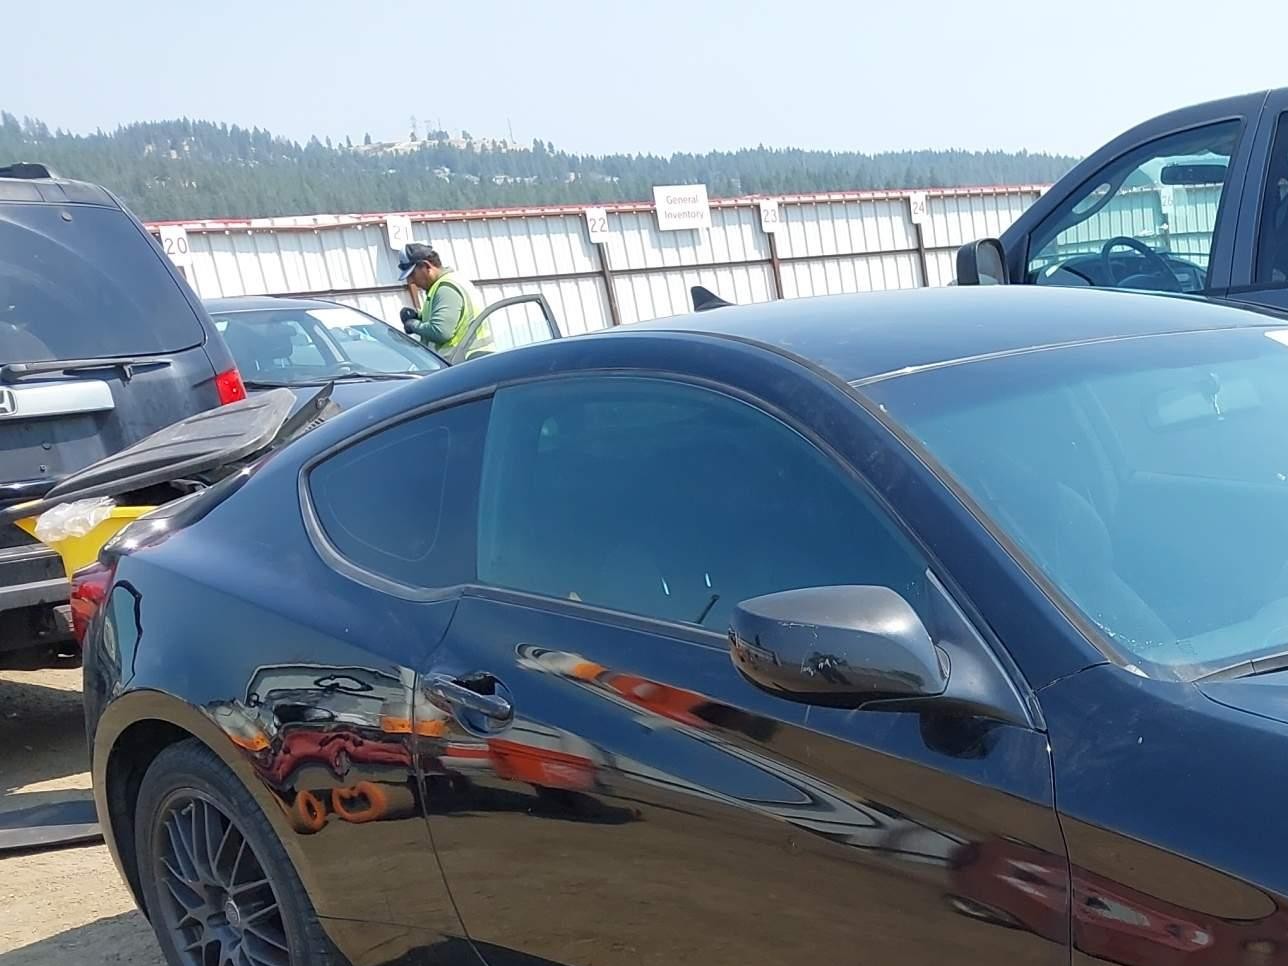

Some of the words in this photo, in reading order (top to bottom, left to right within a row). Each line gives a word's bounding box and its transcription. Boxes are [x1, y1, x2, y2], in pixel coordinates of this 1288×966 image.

[665, 195, 699, 205] General
[664, 207, 704, 219] Inventory
[912, 201, 925, 215] 24
[762, 209, 777, 223] 23
[589, 217, 608, 232] 22
[392, 224, 409, 241] 21
[164, 237, 188, 255] 20
